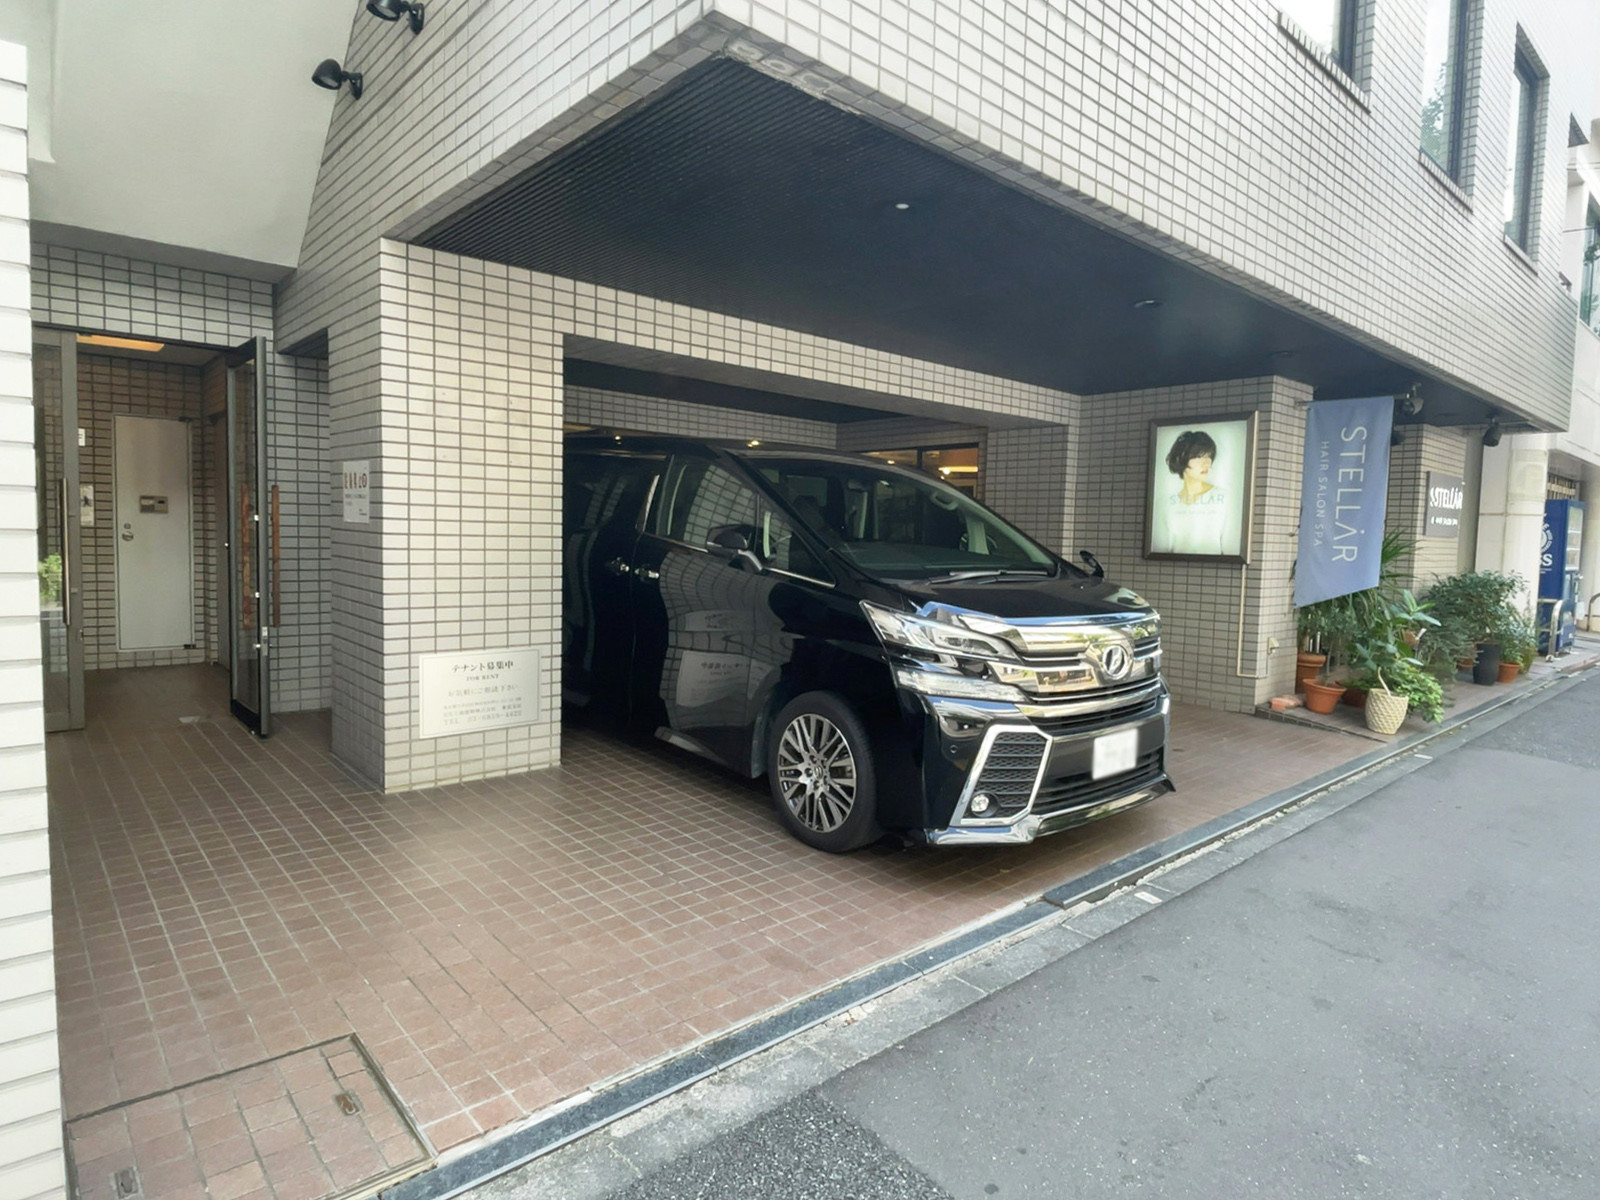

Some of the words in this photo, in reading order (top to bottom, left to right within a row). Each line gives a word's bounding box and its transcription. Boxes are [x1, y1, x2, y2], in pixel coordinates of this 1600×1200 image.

[1319, 441, 1330, 471] HAIR
[1315, 476, 1329, 518] SALON
[1313, 523, 1324, 547] SPA
